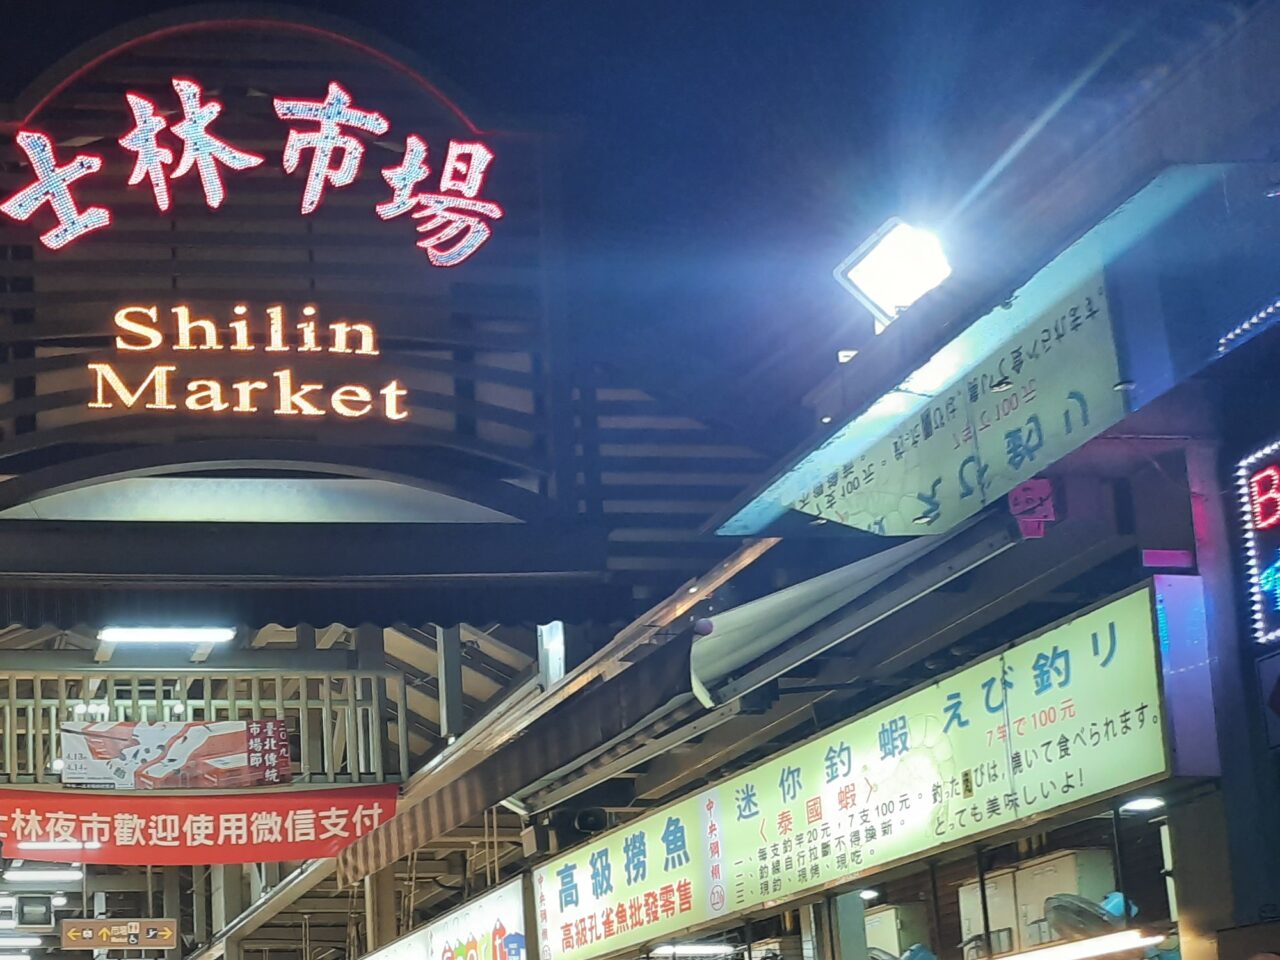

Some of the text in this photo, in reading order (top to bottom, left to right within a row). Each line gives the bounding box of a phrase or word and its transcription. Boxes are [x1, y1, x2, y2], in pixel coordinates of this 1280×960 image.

[0, 77, 503, 268] 士林市場
[114, 303, 380, 356] Shilin
[86, 363, 409, 421] Market
[248, 721, 264, 768] 市場節
[263, 721, 281, 783] 臺北傳統
[734, 715, 910, 822] 迷你釣蝦
[555, 816, 691, 913] 高級撈魚
[560, 878, 693, 953] 高級孔雀魚批發零售
